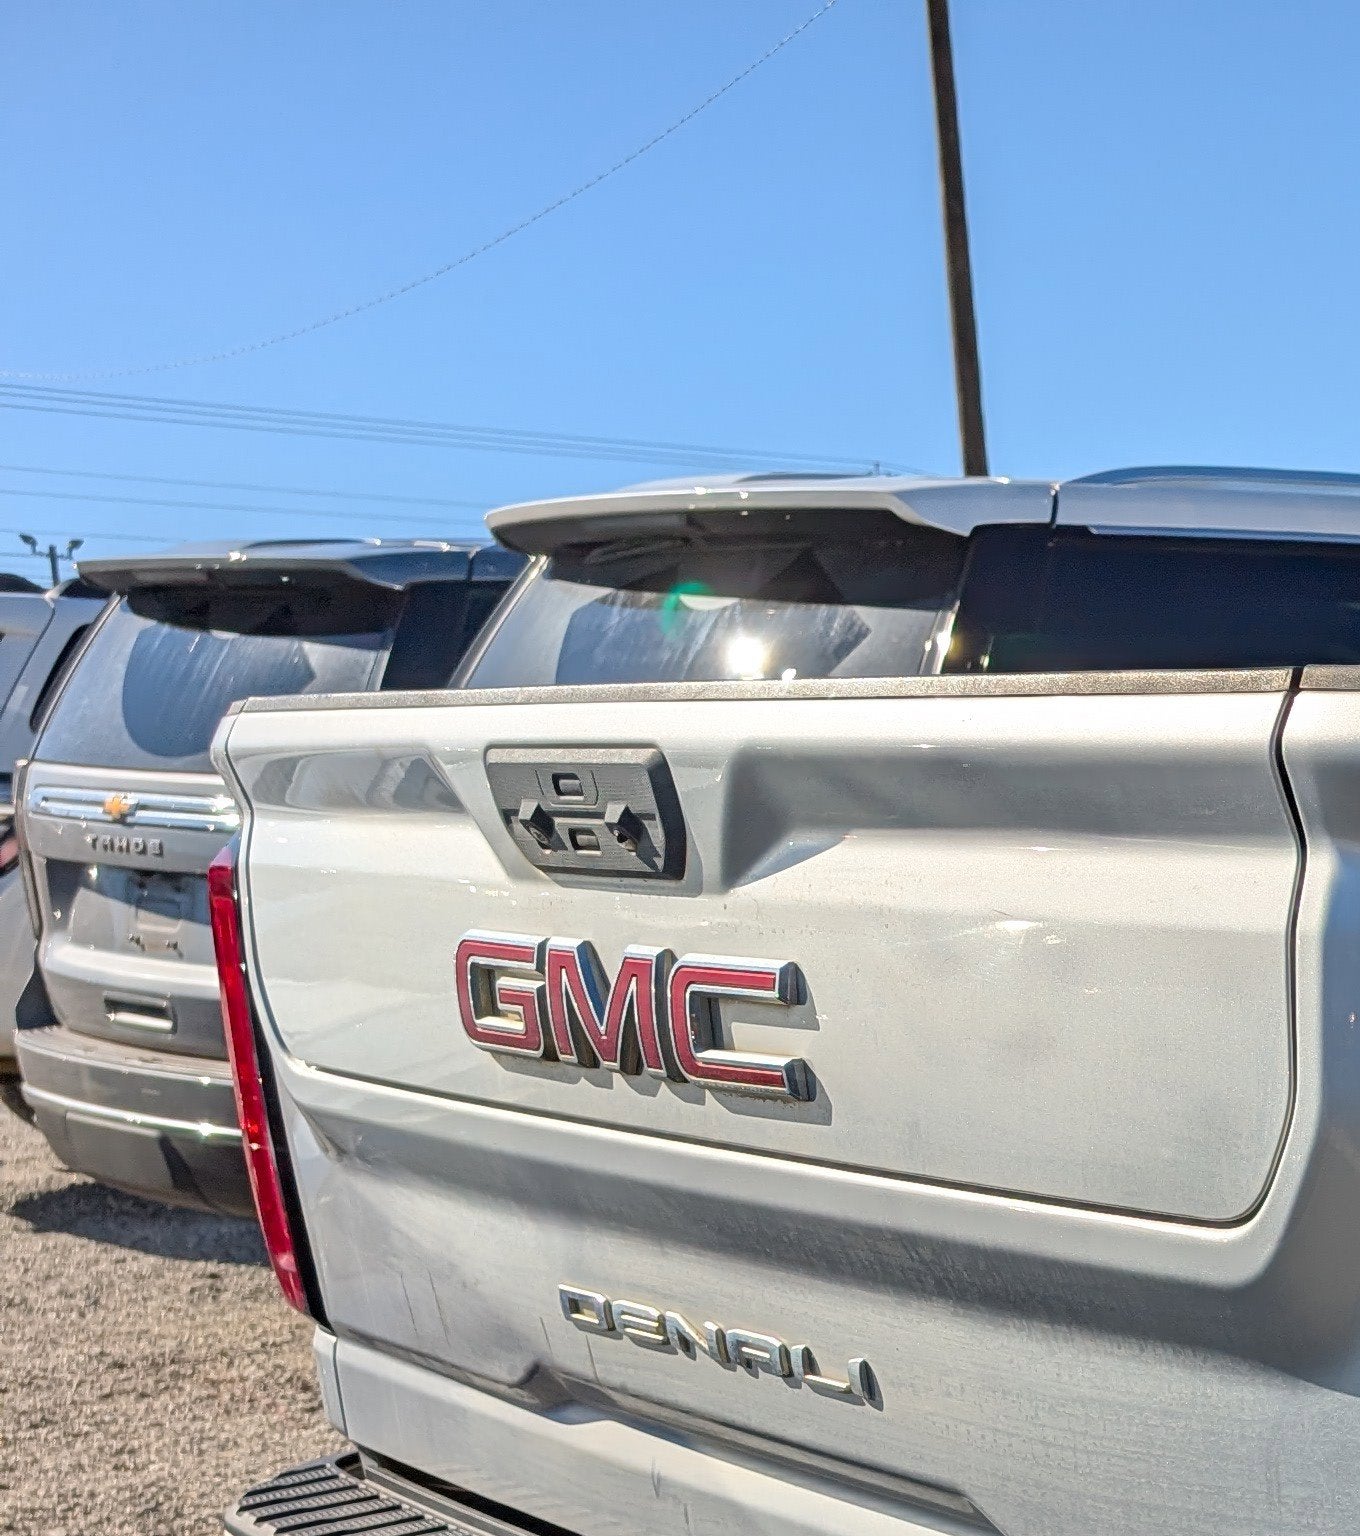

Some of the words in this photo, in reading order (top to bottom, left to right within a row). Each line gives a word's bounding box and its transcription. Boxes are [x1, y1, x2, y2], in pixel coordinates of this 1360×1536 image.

[85, 833, 162, 856] TAHOE
[455, 929, 816, 1102] GMC
[558, 1283, 876, 1406] DENALI
